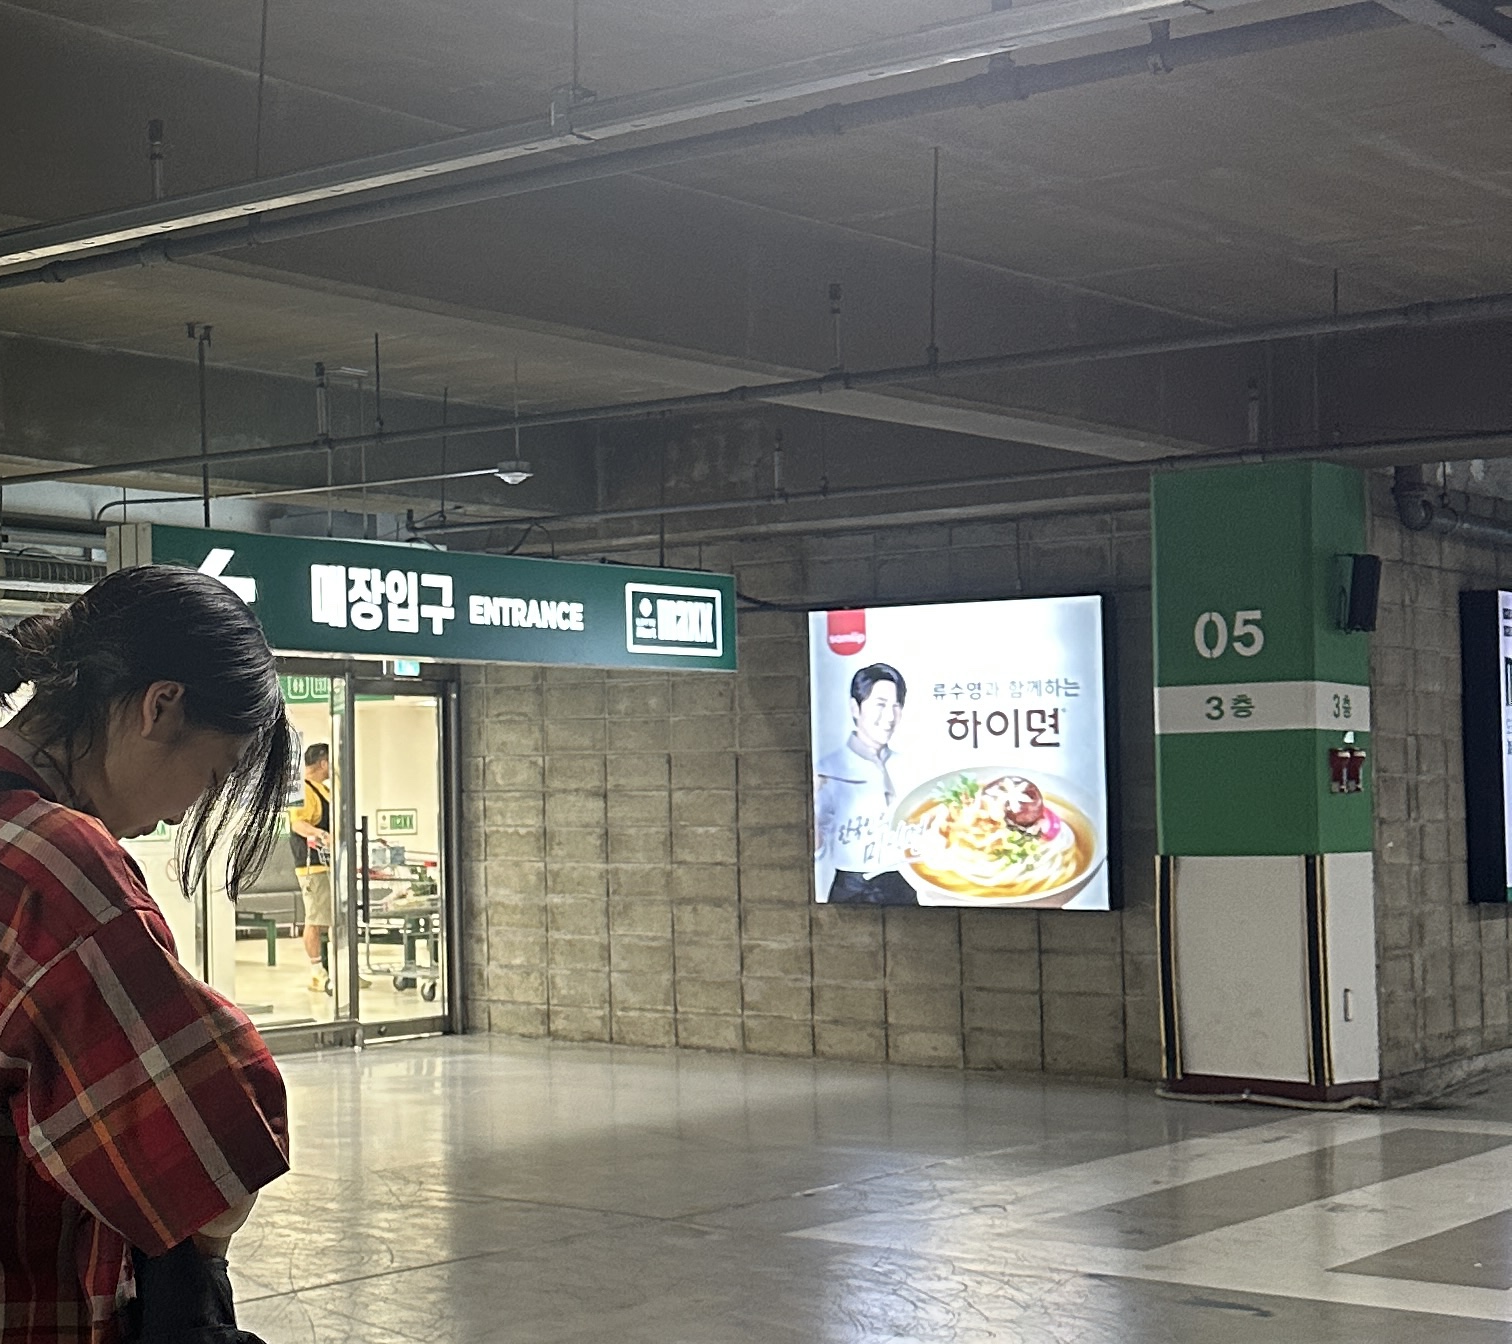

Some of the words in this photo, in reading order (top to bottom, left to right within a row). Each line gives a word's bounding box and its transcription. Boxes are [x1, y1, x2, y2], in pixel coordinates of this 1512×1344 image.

[310, 563, 455, 635] 매장입구
[469, 594, 585, 631] ENTRANCE
[1194, 610, 1264, 659] 05
[933, 681, 1000, 701] 류수영과
[1009, 677, 1081, 699] 함께하는
